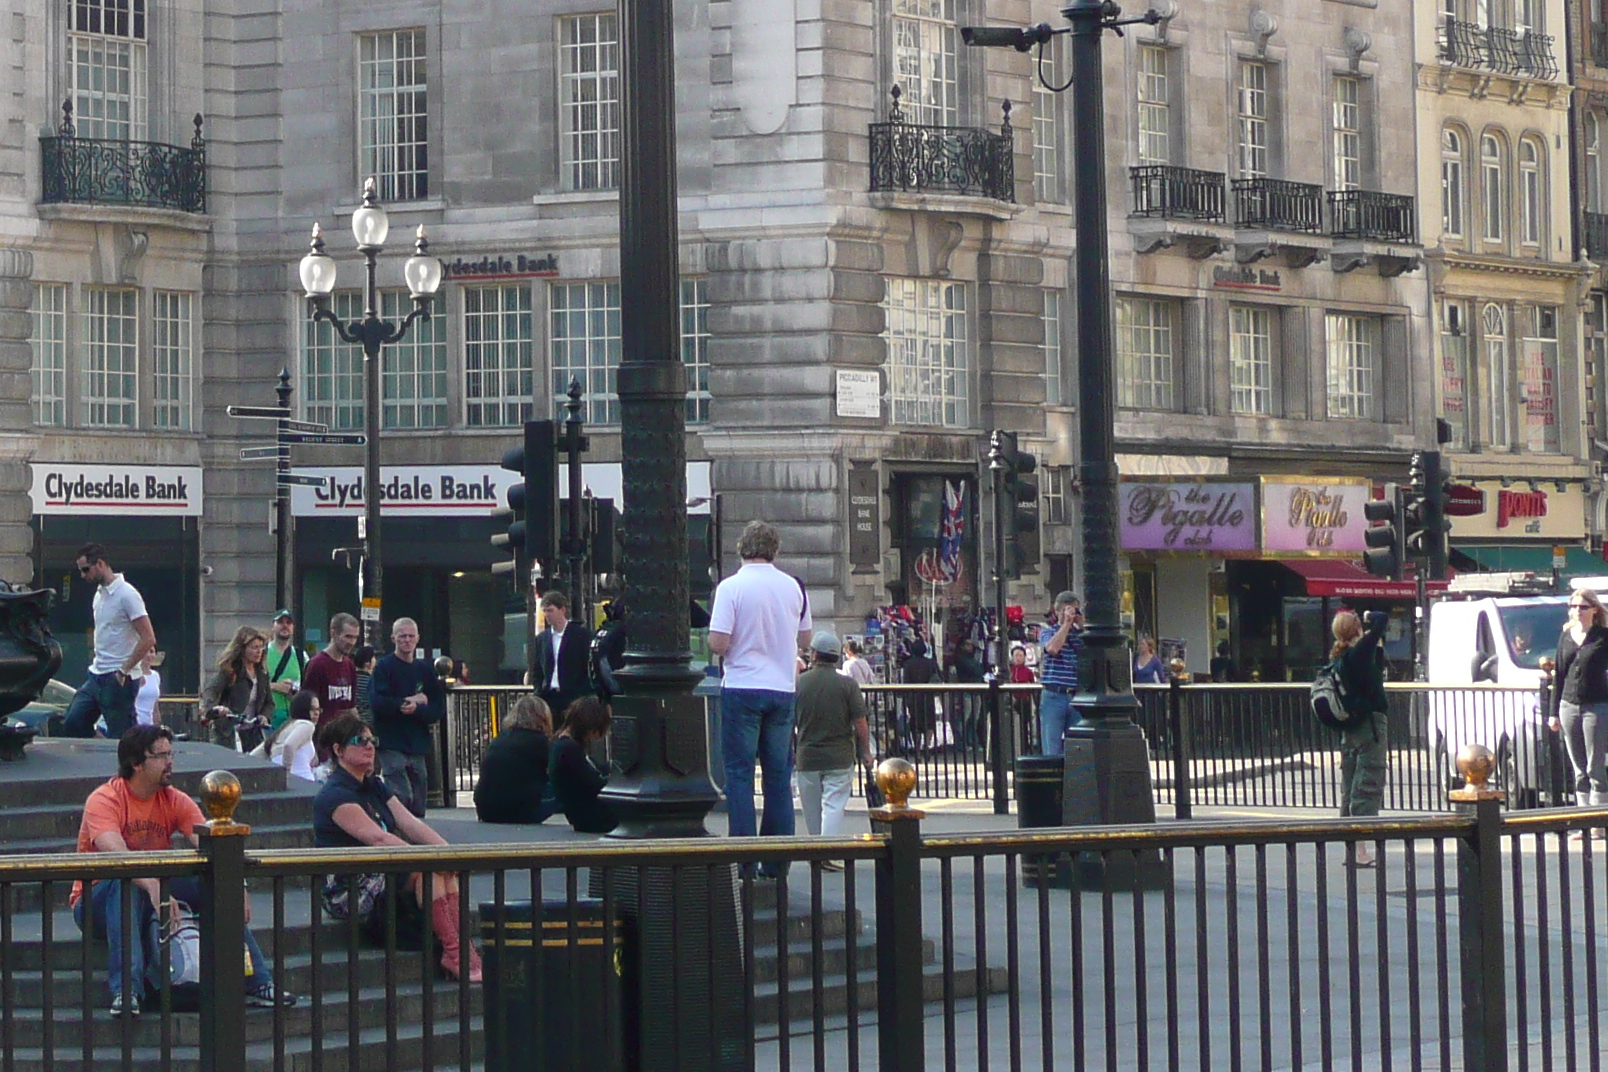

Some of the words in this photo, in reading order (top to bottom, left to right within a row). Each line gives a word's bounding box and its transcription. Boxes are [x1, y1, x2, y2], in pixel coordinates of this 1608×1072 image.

[438, 256, 512, 280] ydesdale
[517, 253, 558, 272] Bank
[45, 473, 140, 506] Clydesdale
[145, 475, 188, 500] Bank
[314, 475, 433, 508] Clydsdale
[440, 475, 497, 500] Bank
[1184, 484, 1211, 504] the
[1127, 485, 1244, 546] Pigalle
